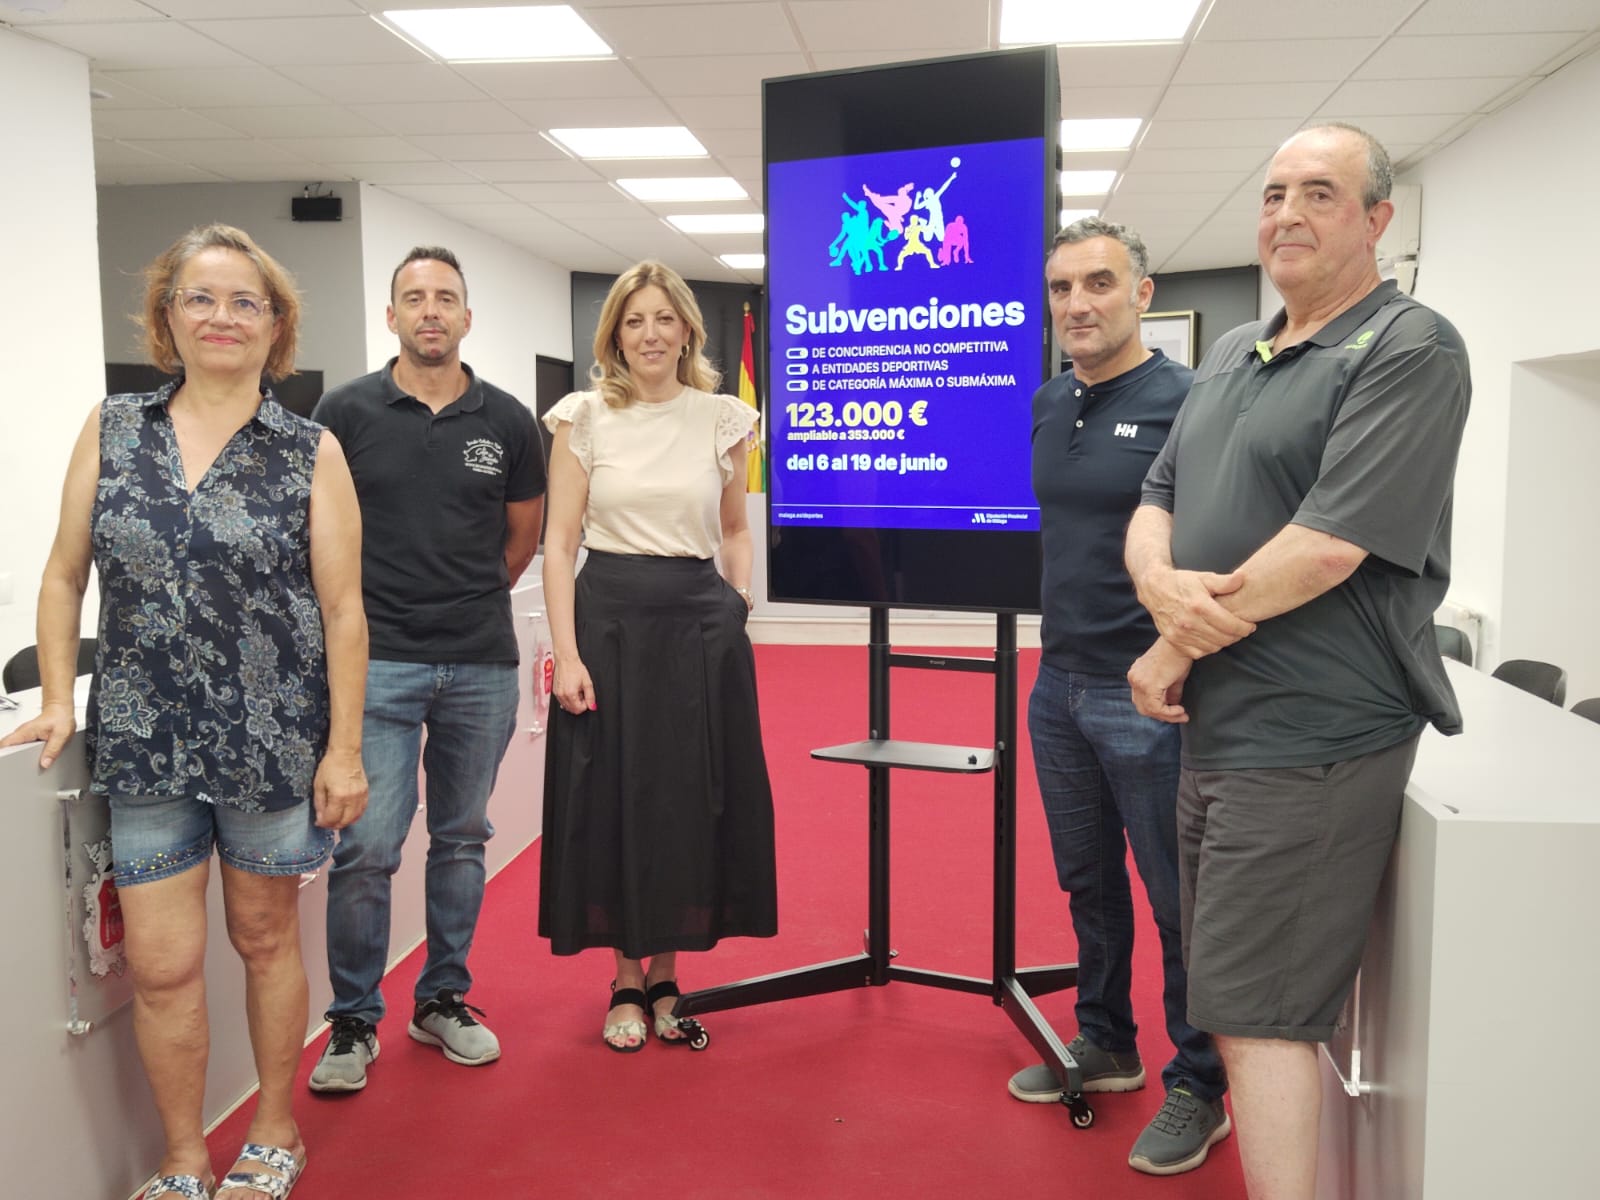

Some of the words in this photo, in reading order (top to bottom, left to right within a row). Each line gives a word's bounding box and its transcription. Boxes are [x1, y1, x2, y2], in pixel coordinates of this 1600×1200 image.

[786, 297, 1025, 335] Subvenciones
[812, 347, 826, 358] DE
[827, 344, 911, 358] CONCURRENCIA
[914, 343, 931, 355] NO
[933, 341, 1008, 354] COMPETITIVA
[812, 364, 821, 374] A
[822, 362, 879, 374] ENTIDADES
[882, 360, 949, 373] DEPORTIVAS
[812, 380, 826, 391] DE
[828, 376, 887, 391] CATEGORÍA
[889, 375, 933, 388] MÁXIMA
[936, 377, 944, 388] O
[946, 373, 1016, 387] SUBMÁXIMA
[786, 401, 903, 427] 123.000
[908, 400, 928, 426] €
[787, 430, 838, 443] ampliable
[839, 432, 846, 440] a
[847, 429, 895, 440] 353.000
[897, 429, 905, 440] €
[1114, 423, 1138, 438] HH
[786, 454, 814, 470] del
[816, 454, 829, 471] 6
[831, 454, 848, 470] al
[850, 454, 872, 471] 19
[874, 454, 898, 471] de
[899, 453, 948, 475] junio
